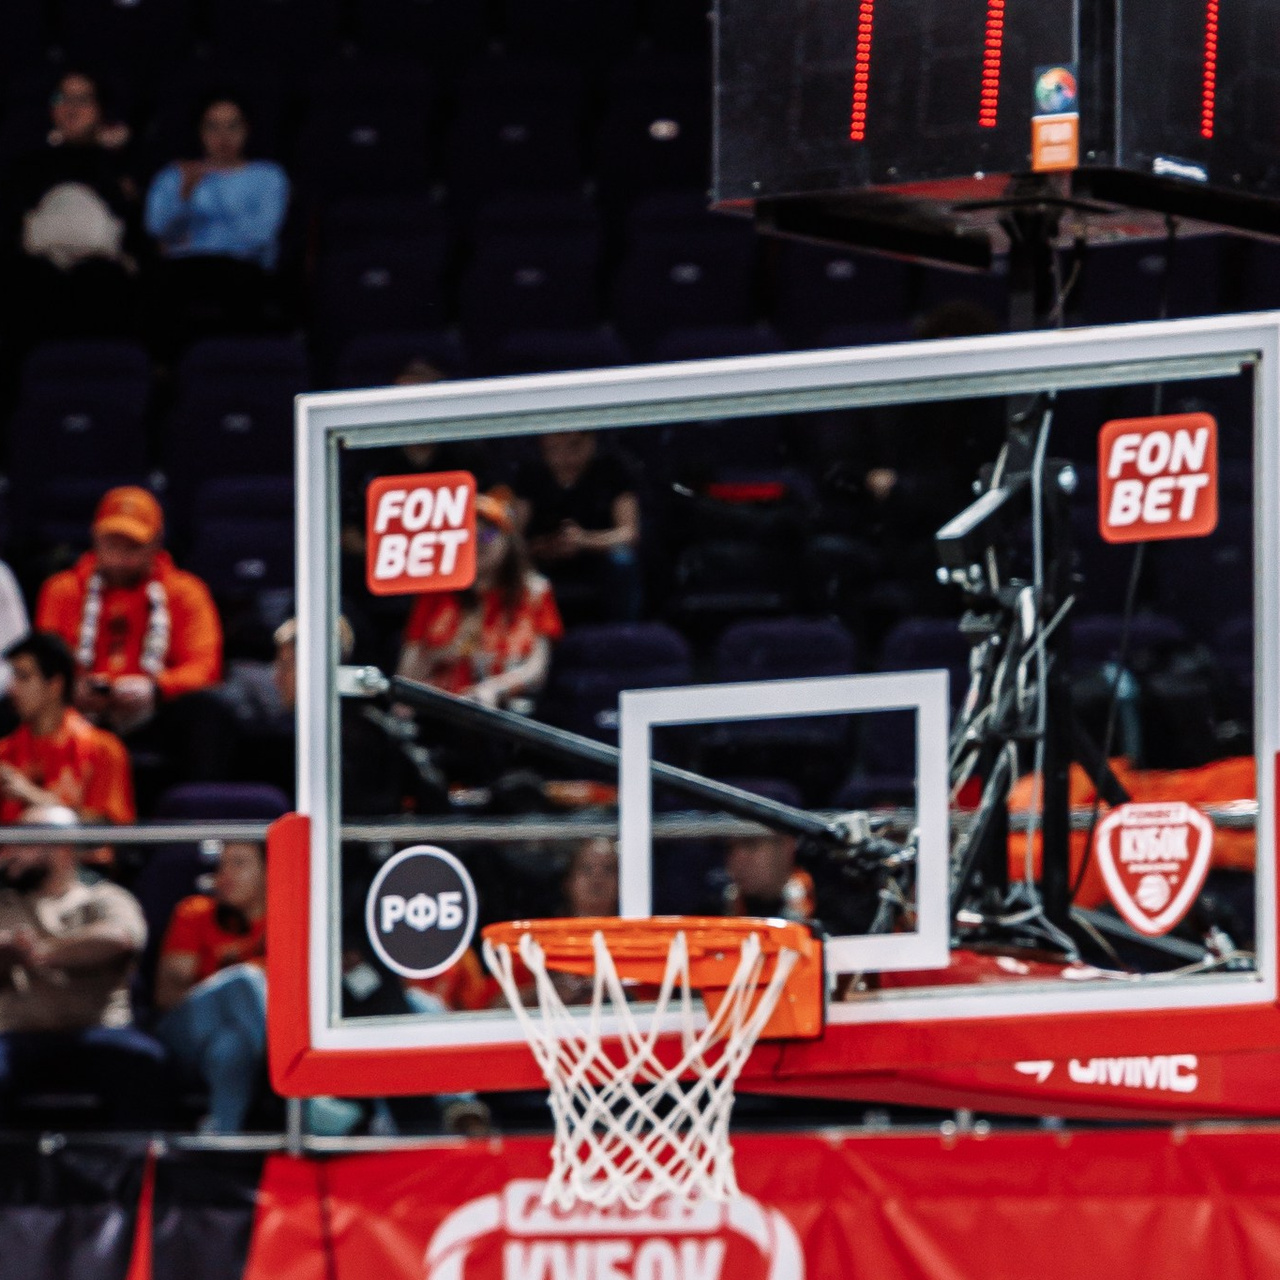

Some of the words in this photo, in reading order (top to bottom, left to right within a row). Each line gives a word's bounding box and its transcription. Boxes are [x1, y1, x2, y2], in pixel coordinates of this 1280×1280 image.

[1107, 427, 1209, 479] FON
[373, 484, 469, 534] FON
[1107, 473, 1210, 527] BET
[373, 528, 470, 580] BET
[381, 891, 463, 934] РФБ
